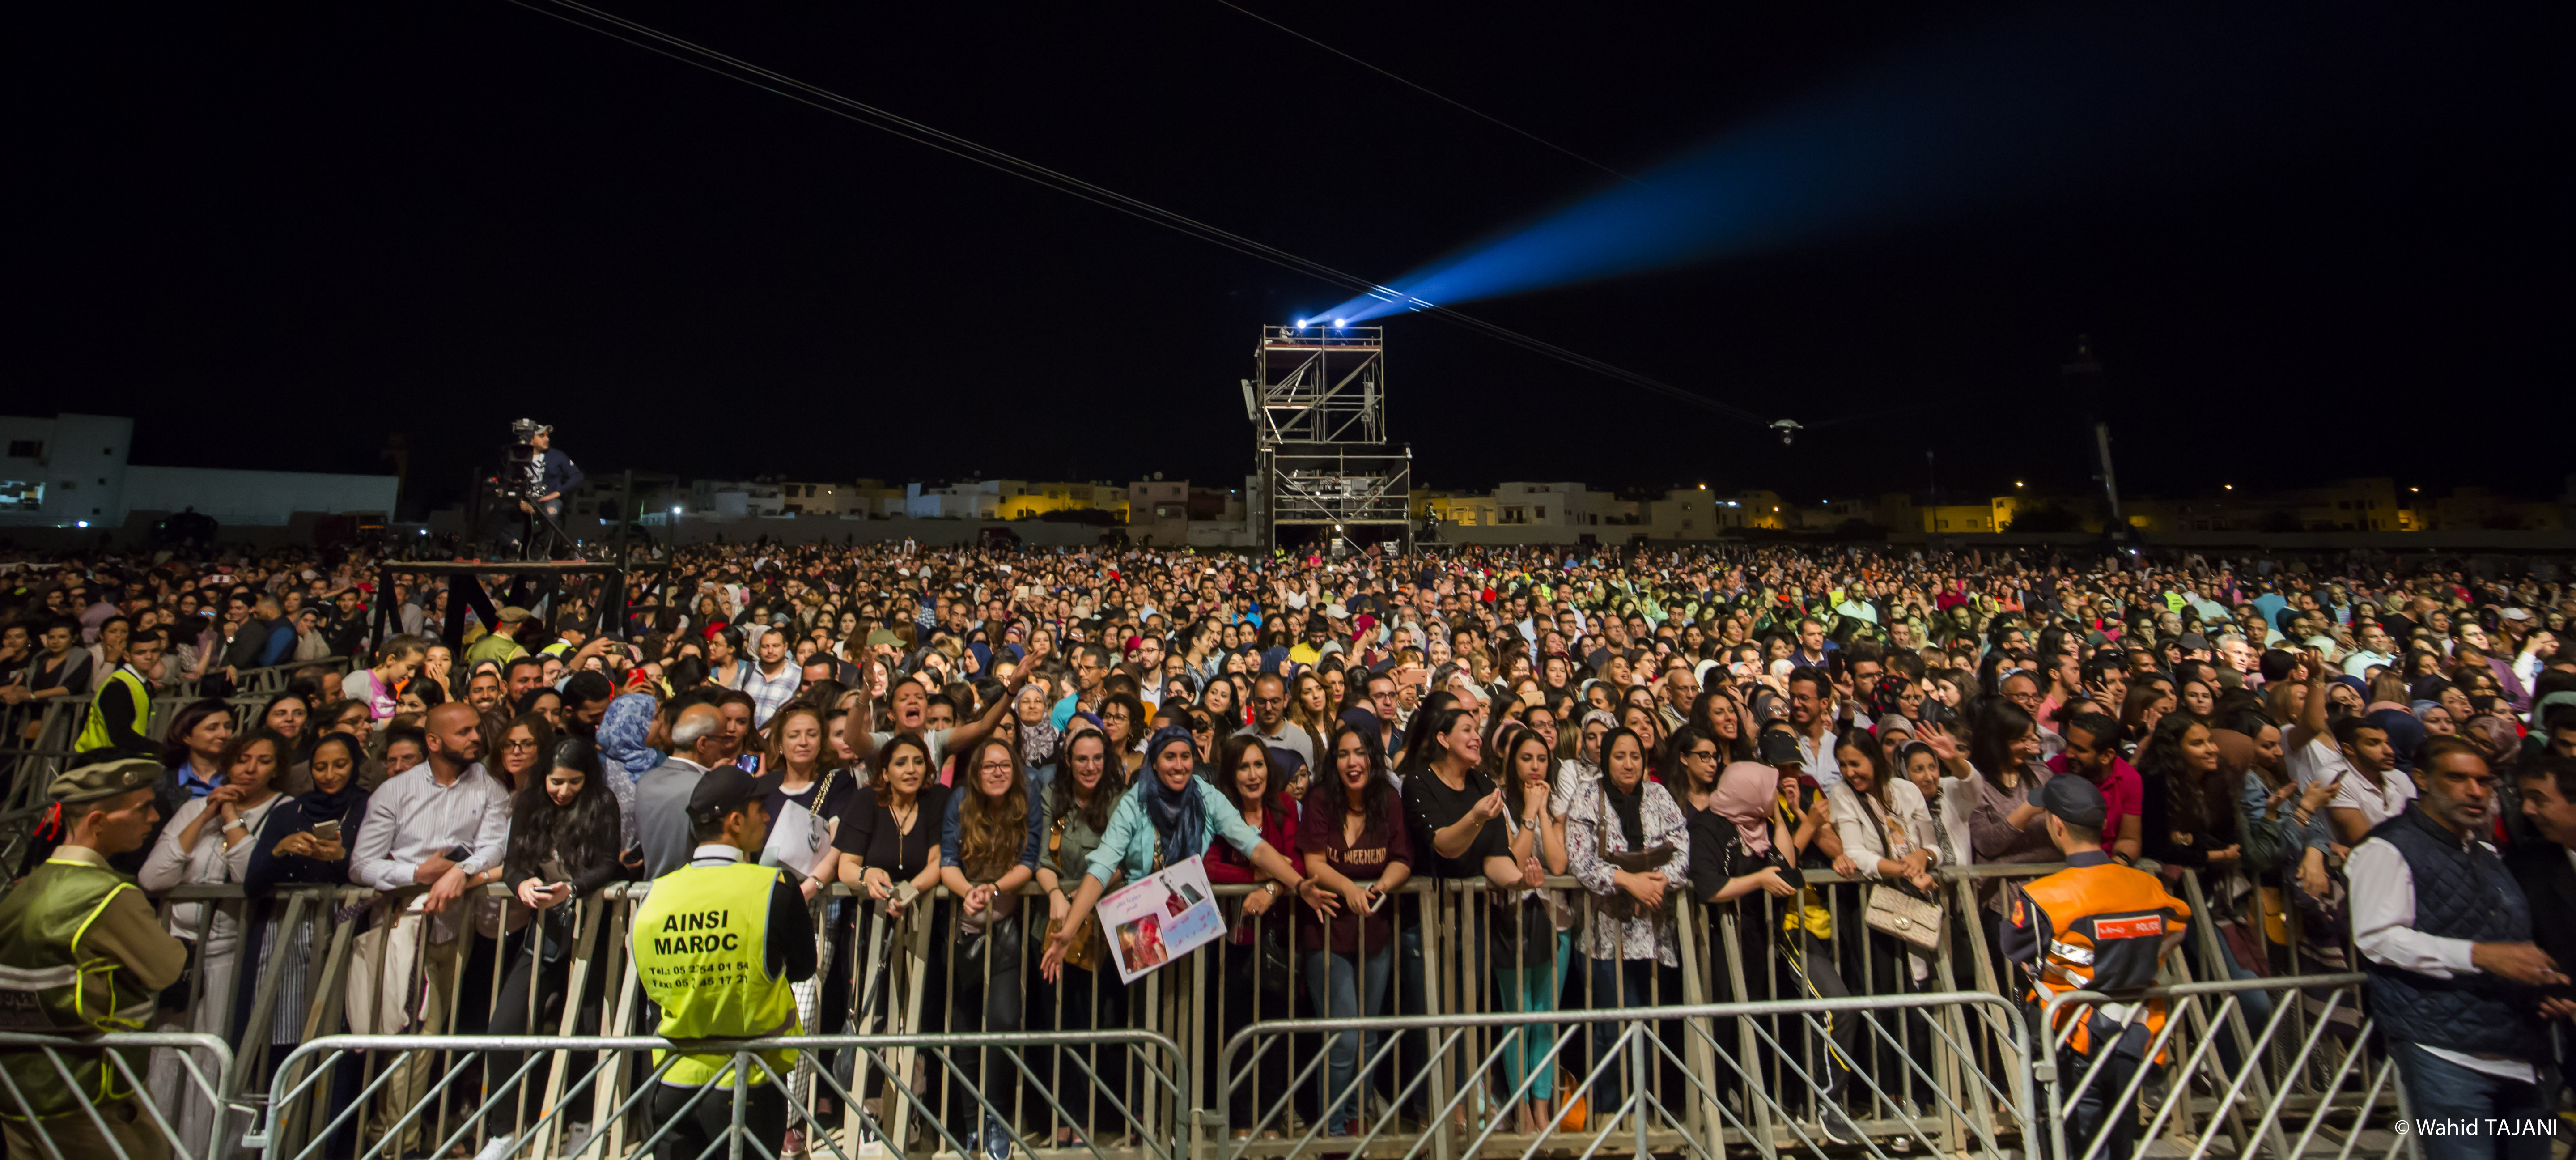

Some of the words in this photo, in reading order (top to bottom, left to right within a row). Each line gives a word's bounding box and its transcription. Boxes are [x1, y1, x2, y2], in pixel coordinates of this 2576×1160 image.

[663, 910, 728, 932] AINSI
[654, 933, 738, 955] MAROC
[673, 966, 686, 975] 05
[718, 962, 731, 972] 01
[675, 978, 688, 987] 05
[718, 976, 732, 985] 17
